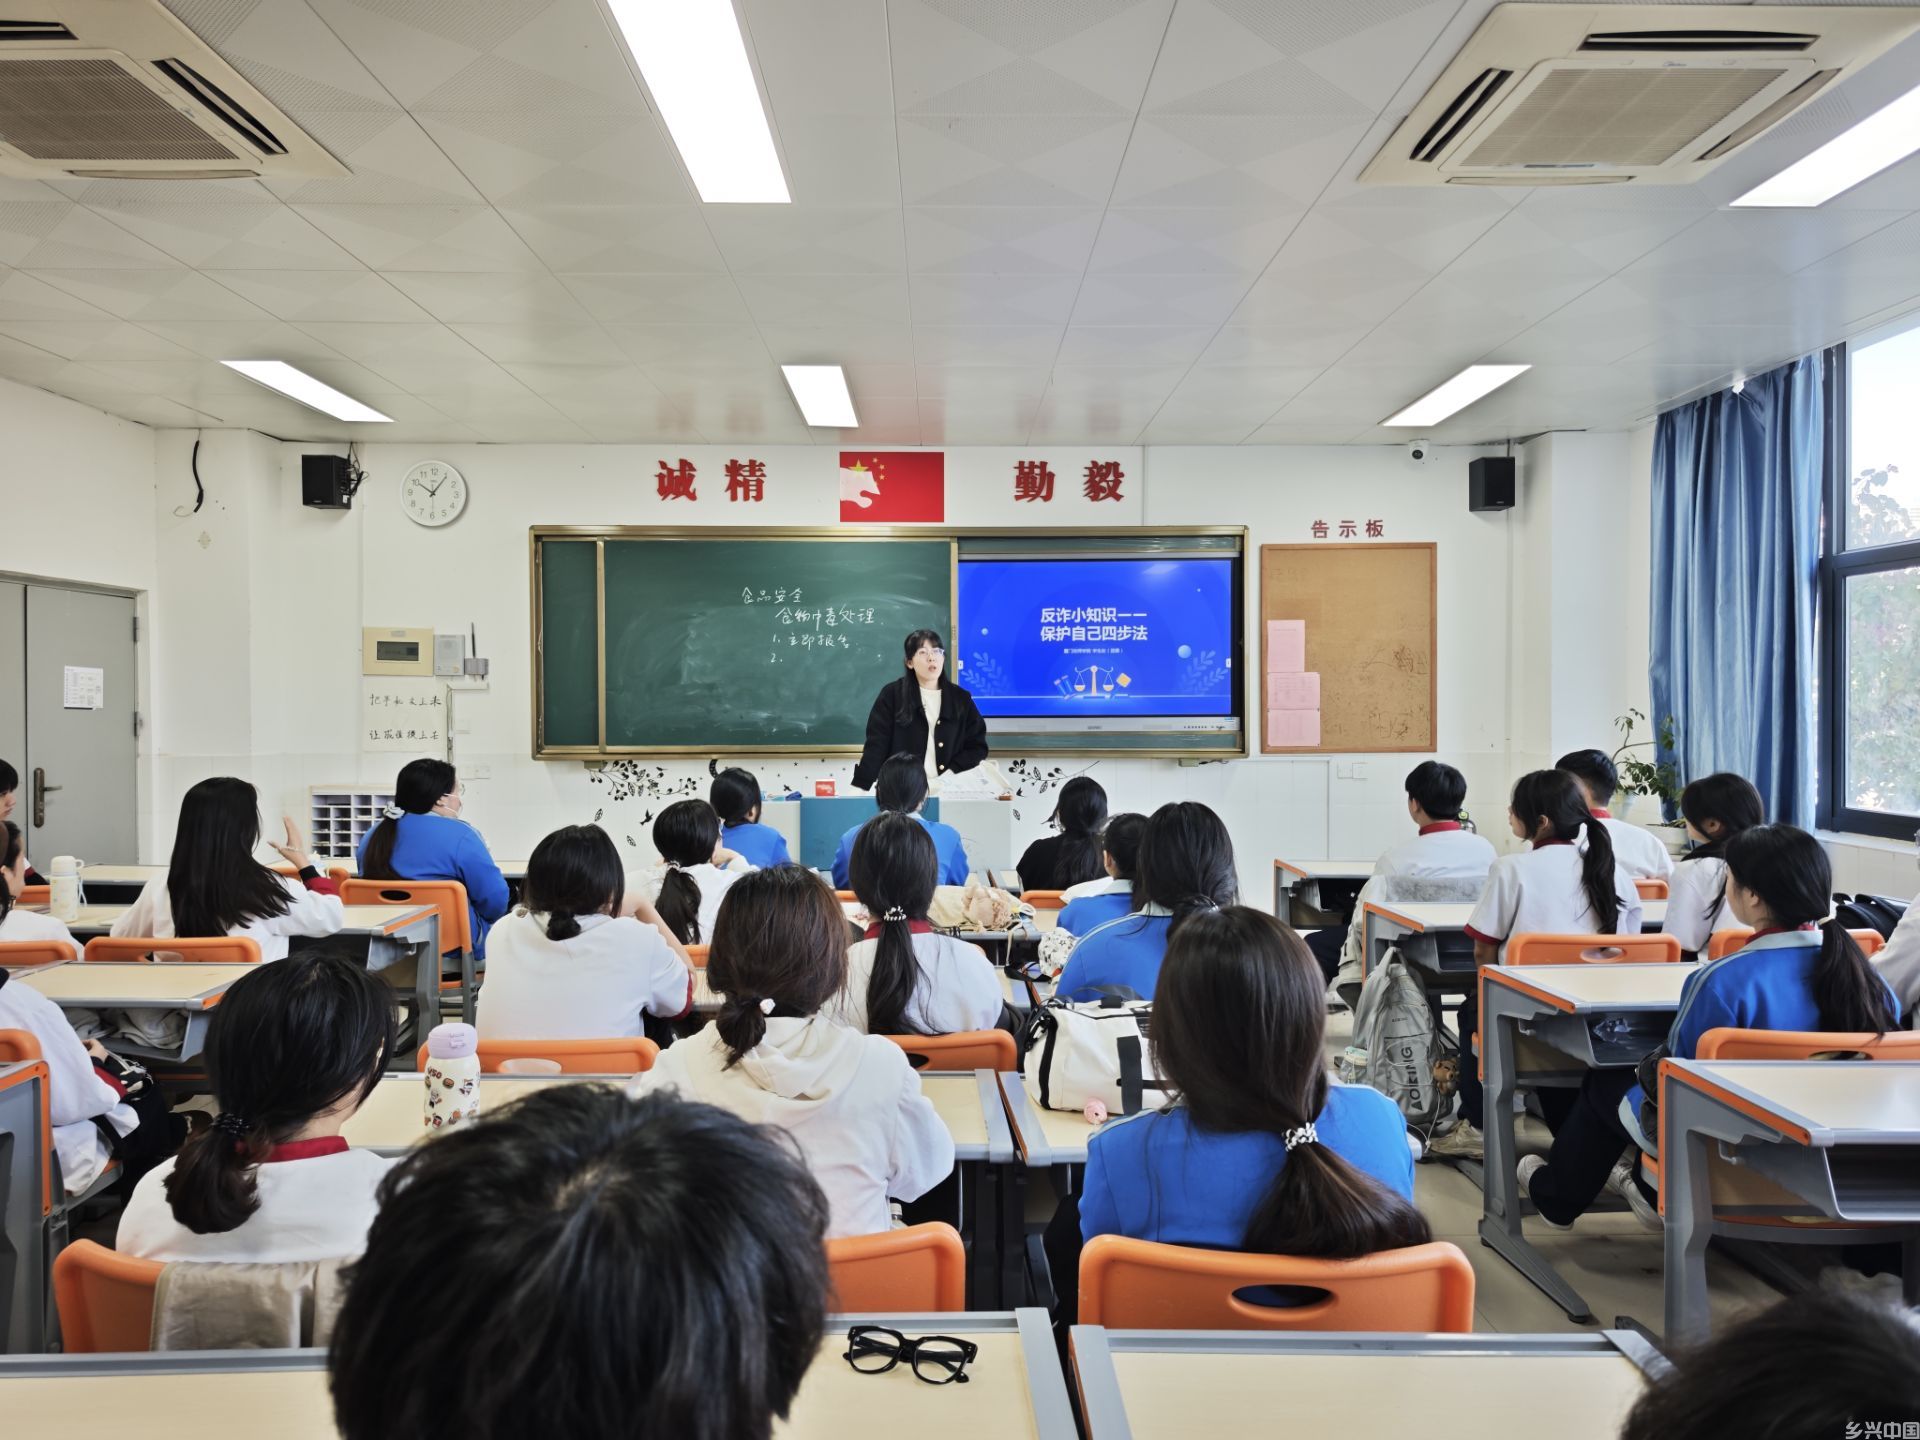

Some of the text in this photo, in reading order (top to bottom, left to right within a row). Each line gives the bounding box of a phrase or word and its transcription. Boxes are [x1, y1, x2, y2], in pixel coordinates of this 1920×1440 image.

[1311, 519, 1384, 539] 告示板
[742, 586, 803, 604] 食品安全
[1040, 625, 1148, 641] 保护自己四步法
[1401, 1046, 1423, 1111] AOKING
